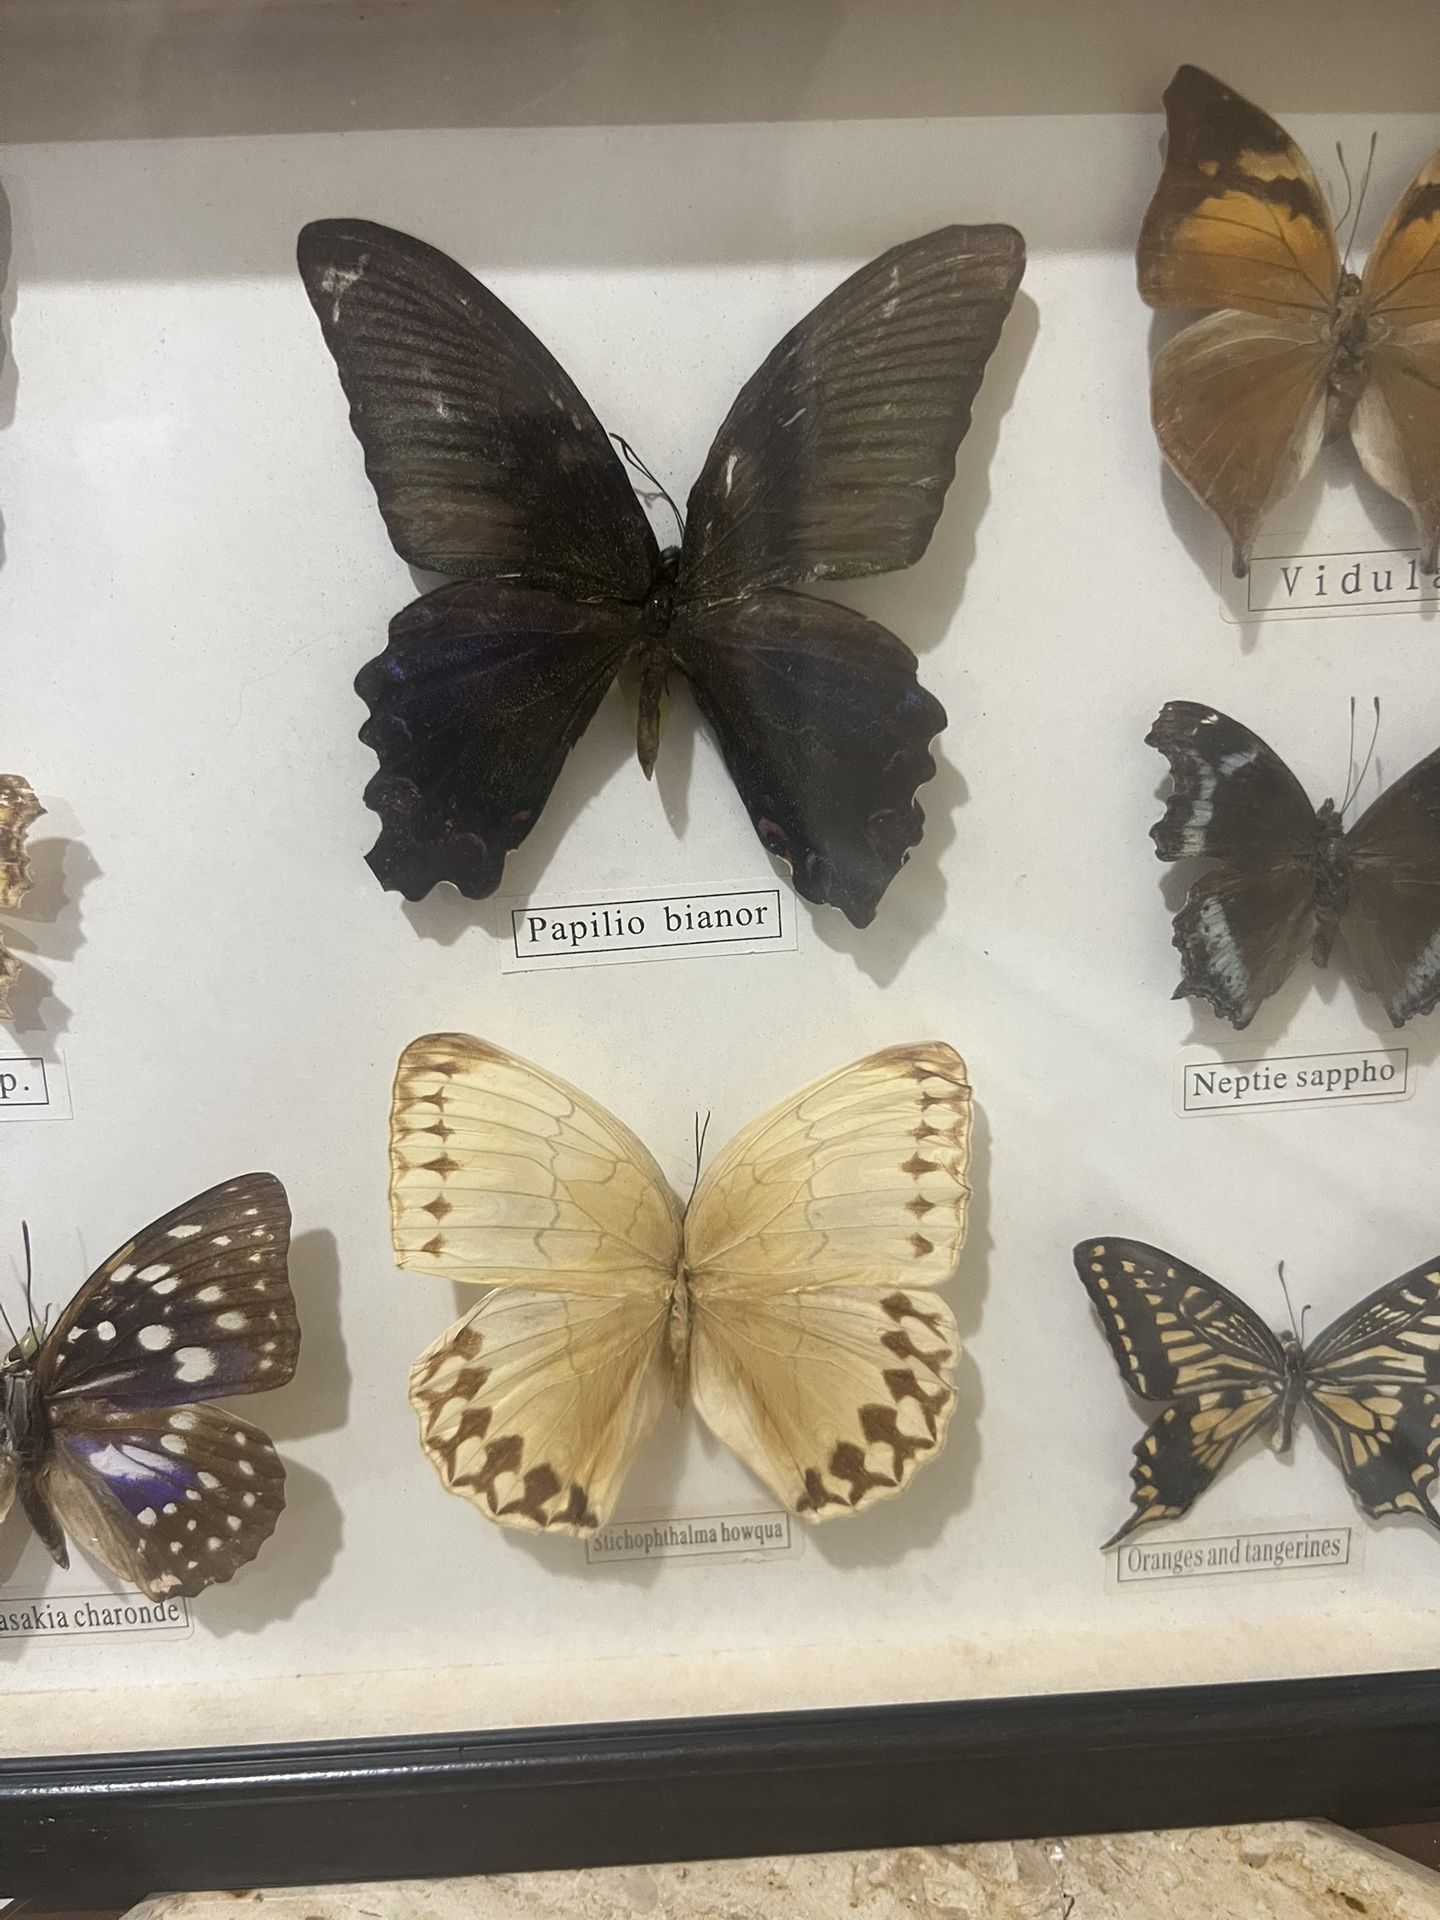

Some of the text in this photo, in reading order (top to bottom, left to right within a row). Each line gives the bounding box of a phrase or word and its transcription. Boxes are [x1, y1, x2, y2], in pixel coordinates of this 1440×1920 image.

[527, 904, 769, 947] Papilio bianor
[1192, 1060, 1396, 1099] Neptie sappho
[593, 1522, 783, 1554] Stichophthalma howqua
[1127, 1534, 1341, 1575] Oranges and tangerines
[0, 1602, 181, 1631] asakia charonde
